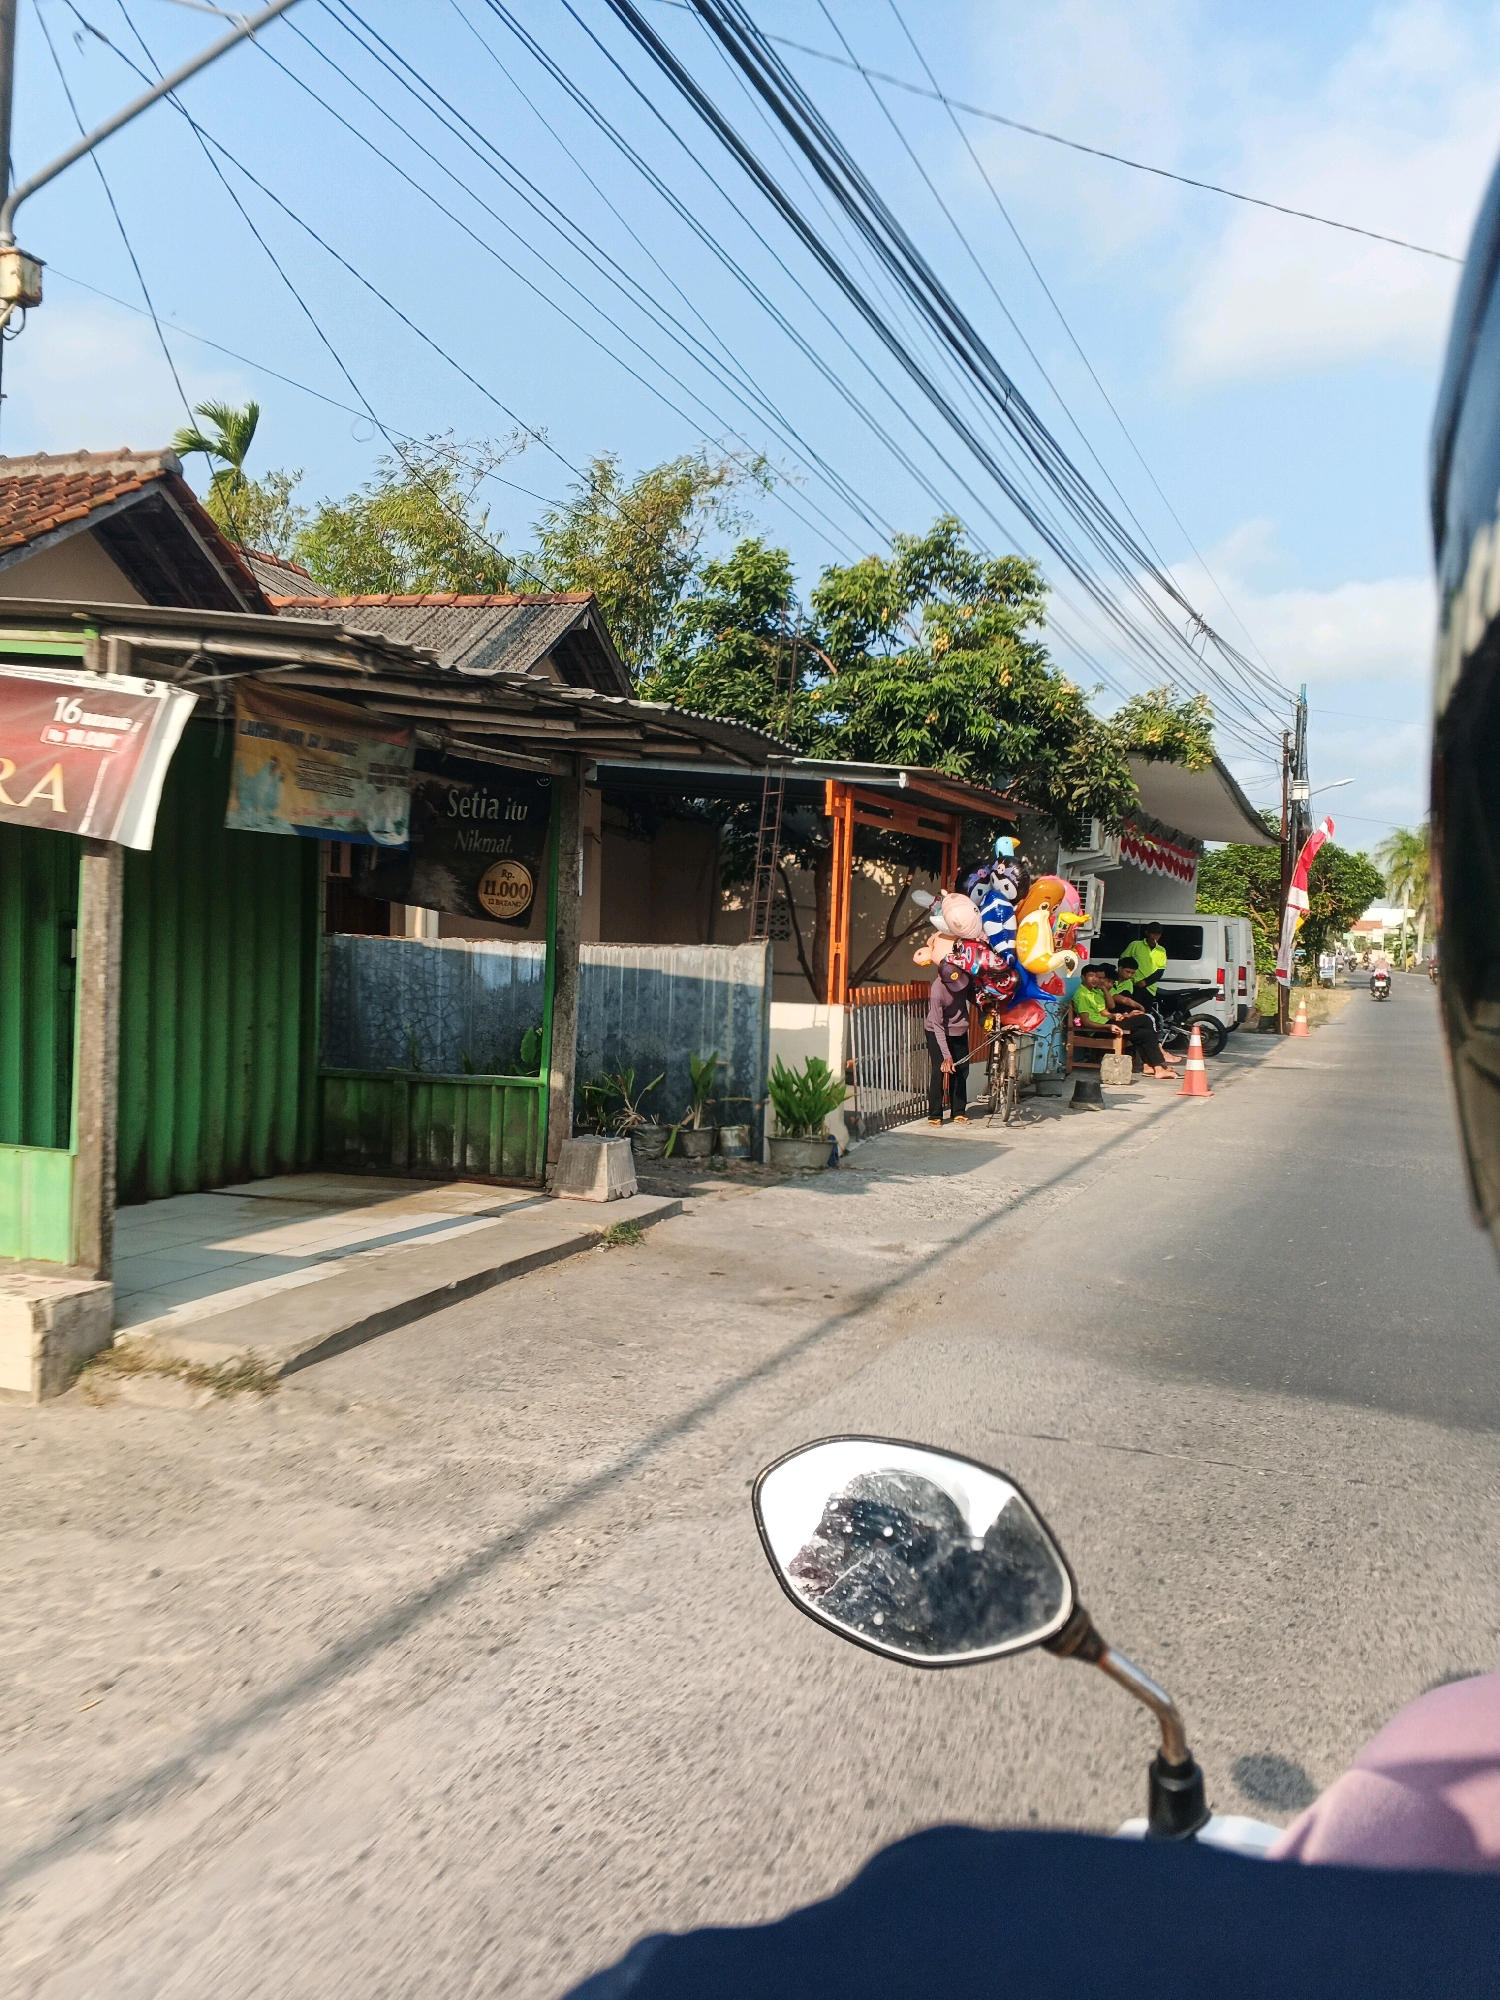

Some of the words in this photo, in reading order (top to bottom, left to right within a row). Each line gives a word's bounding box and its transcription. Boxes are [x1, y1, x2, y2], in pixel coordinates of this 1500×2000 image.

[53, 697, 83, 724] 16
[447, 787, 500, 820] Setia
[504, 797, 529, 821] itu
[454, 829, 514, 854] Nikmat.
[501, 869, 515, 881] Rp.
[483, 880, 528, 900] 11.000
